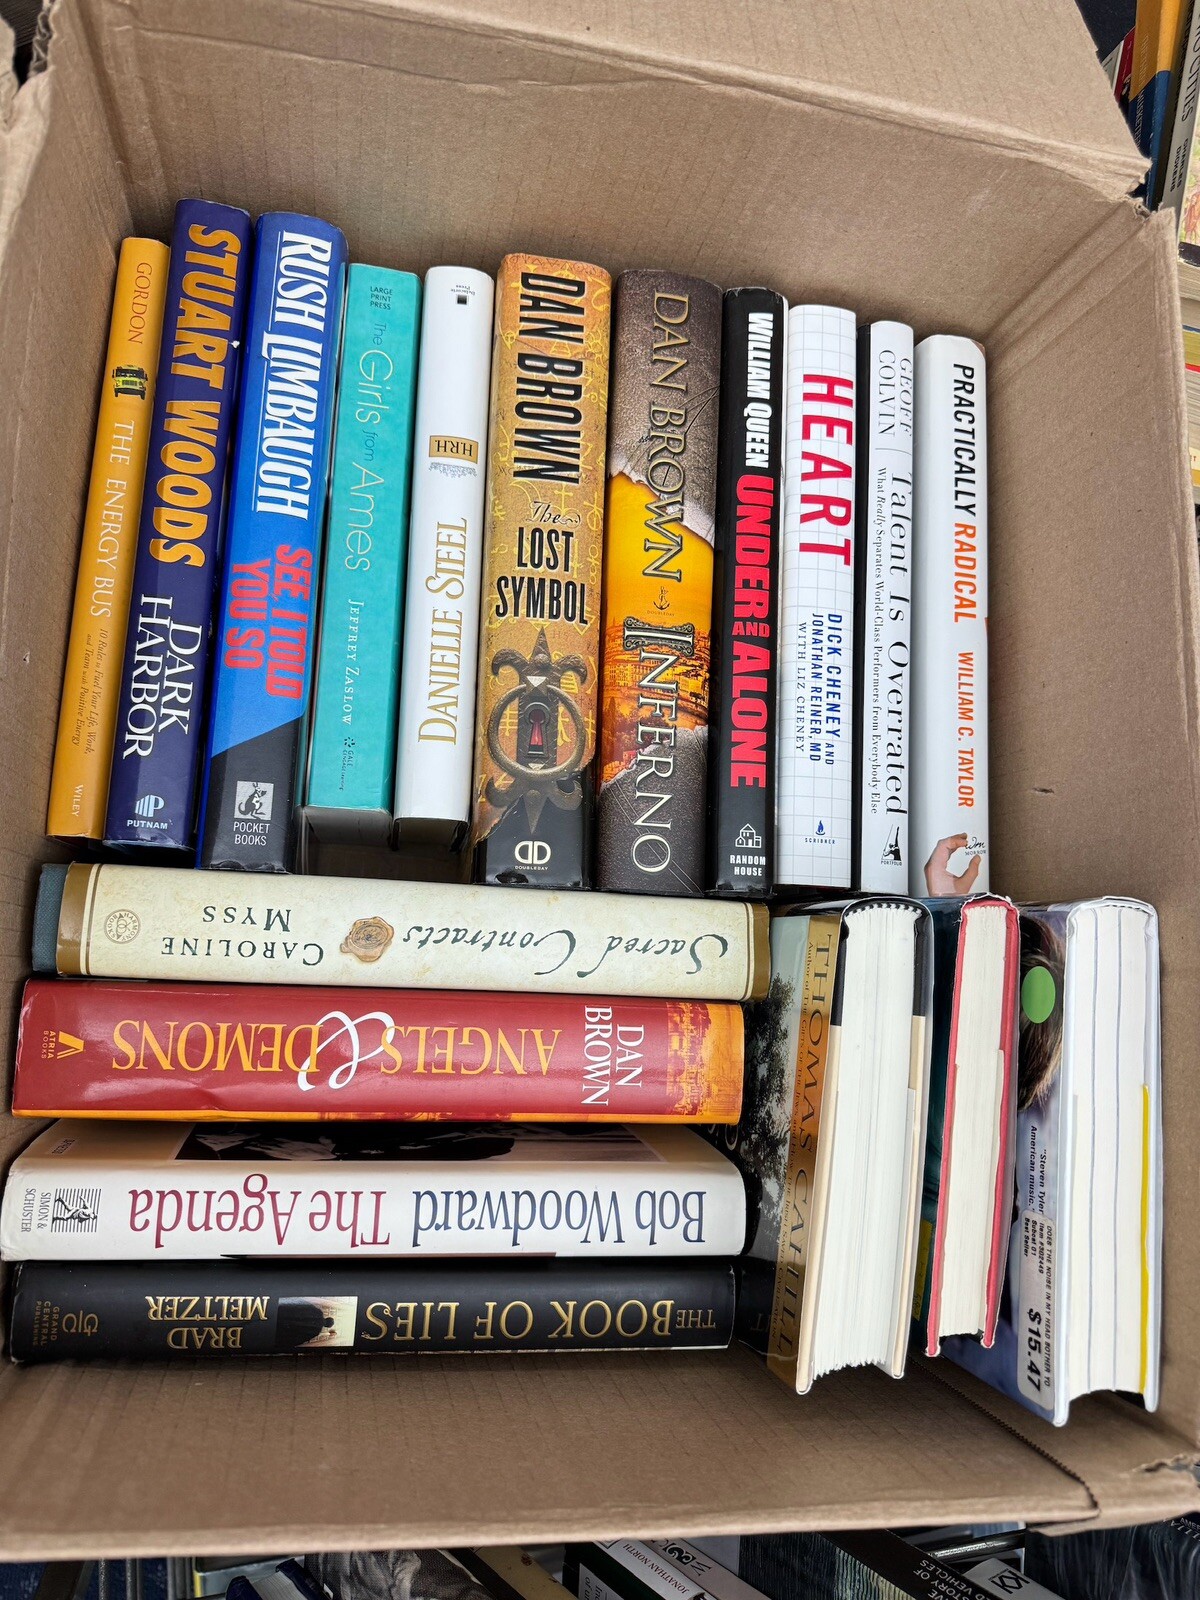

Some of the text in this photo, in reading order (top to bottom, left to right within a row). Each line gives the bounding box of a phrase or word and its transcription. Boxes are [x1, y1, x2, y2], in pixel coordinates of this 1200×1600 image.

[1170, 145, 1181, 192] DICKENS
[1177, 138, 1188, 188] CHARLES
[128, 262, 153, 344] GORDON
[369, 286, 393, 296] LARGE
[369, 294, 392, 303] PRINT
[369, 301, 392, 311] PRESS
[150, 223, 242, 568] STUART WOODS
[256, 230, 333, 521] RUSH LIMBAUGH
[513, 271, 586, 485] DAN BROWN
[743, 312, 774, 469] WILLIAM QUEEN
[878, 349, 897, 437] COLVIN
[344, 322, 393, 573] The Girls from Ames
[642, 289, 689, 583] DAN BROWN
[799, 373, 854, 567] HEART
[953, 363, 977, 623] PRACTICALLY RADICAL
[90, 420, 135, 618] THE ENERGY BUS
[526, 501, 581, 525] The
[274, 544, 312, 601] SEE
[517, 527, 574, 573] LOST
[225, 559, 271, 669] YOU SO
[495, 575, 588, 625] SYMBOL
[97, 640, 107, 661] Rules
[99, 628, 108, 639] 10
[417, 517, 468, 745] DANIELLE STEEL
[730, 474, 774, 788] UNDER AND ALONE
[868, 467, 887, 814] What Really Separates World-Class Performers from Everybody Else
[885, 471, 912, 815] Talent Is Overrated
[83, 649, 95, 669] Team
[93, 670, 104, 690] Fuel
[122, 594, 173, 759] HARBOR
[158, 621, 202, 734] DARK
[266, 627, 307, 699] TOLD
[342, 599, 364, 726] JEFFREY ZASLOW
[77, 686, 89, 716] Positive
[91, 691, 102, 710] Your
[796, 622, 807, 752] WITH LIZ CHENEY
[809, 613, 824, 762] JONATHAN REINER, MD
[825, 613, 842, 765] DICK CHENEY AND
[72, 719, 85, 746] Energy
[85, 731, 96, 755] Work,
[623, 616, 695, 874] INFERNO
[957, 651, 974, 808] WILLIAM C. TAYLOR
[71, 784, 84, 817] WILEY
[126, 819, 168, 830] PUTNAM
[233, 822, 270, 834] POCKET
[234, 834, 267, 846] BOOKS
[730, 854, 766, 865] RANDOM
[734, 866, 762, 876] HOUSE
[202, 905, 292, 933] MYSS
[161, 936, 324, 966] CAROLINE
[403, 924, 729, 978] Sacred Contracts
[41, 1030, 49, 1060] BOOKS
[48, 1030, 57, 1059] ATRIA
[111, 1010, 562, 1092] ANGELS & DEMONS
[580, 1005, 613, 1106] BROWN
[614, 1024, 645, 1088] DAN
[778, 934, 832, 1351] THOMAS CAHILL
[20, 1187, 37, 1233] SCHUSTER
[38, 1191, 52, 1221] SIMON
[128, 1173, 707, 1249] Bob Woodward The Agenda
[1038, 1191, 1046, 1215] Tyler
[33, 1300, 42, 1347] PUBLISHING
[41, 1300, 52, 1346] CENTRAL
[50, 1306, 60, 1342] GRAND
[144, 1296, 271, 1321] MELTZER
[361, 1301, 461, 1342] LIES
[473, 1300, 534, 1340] OF
[547, 1299, 675, 1339] BOOK
[676, 1308, 716, 1329] THE
[1045, 1302, 1051, 1316] MY
[166, 1327, 243, 1350] BRAD
[1027, 1308, 1042, 1392] $15.47
[622, 1543, 690, 1594] JONATHAN NORTH
[913, 1569, 930, 1580] OF
[920, 1559, 973, 1595] VEHICLES
